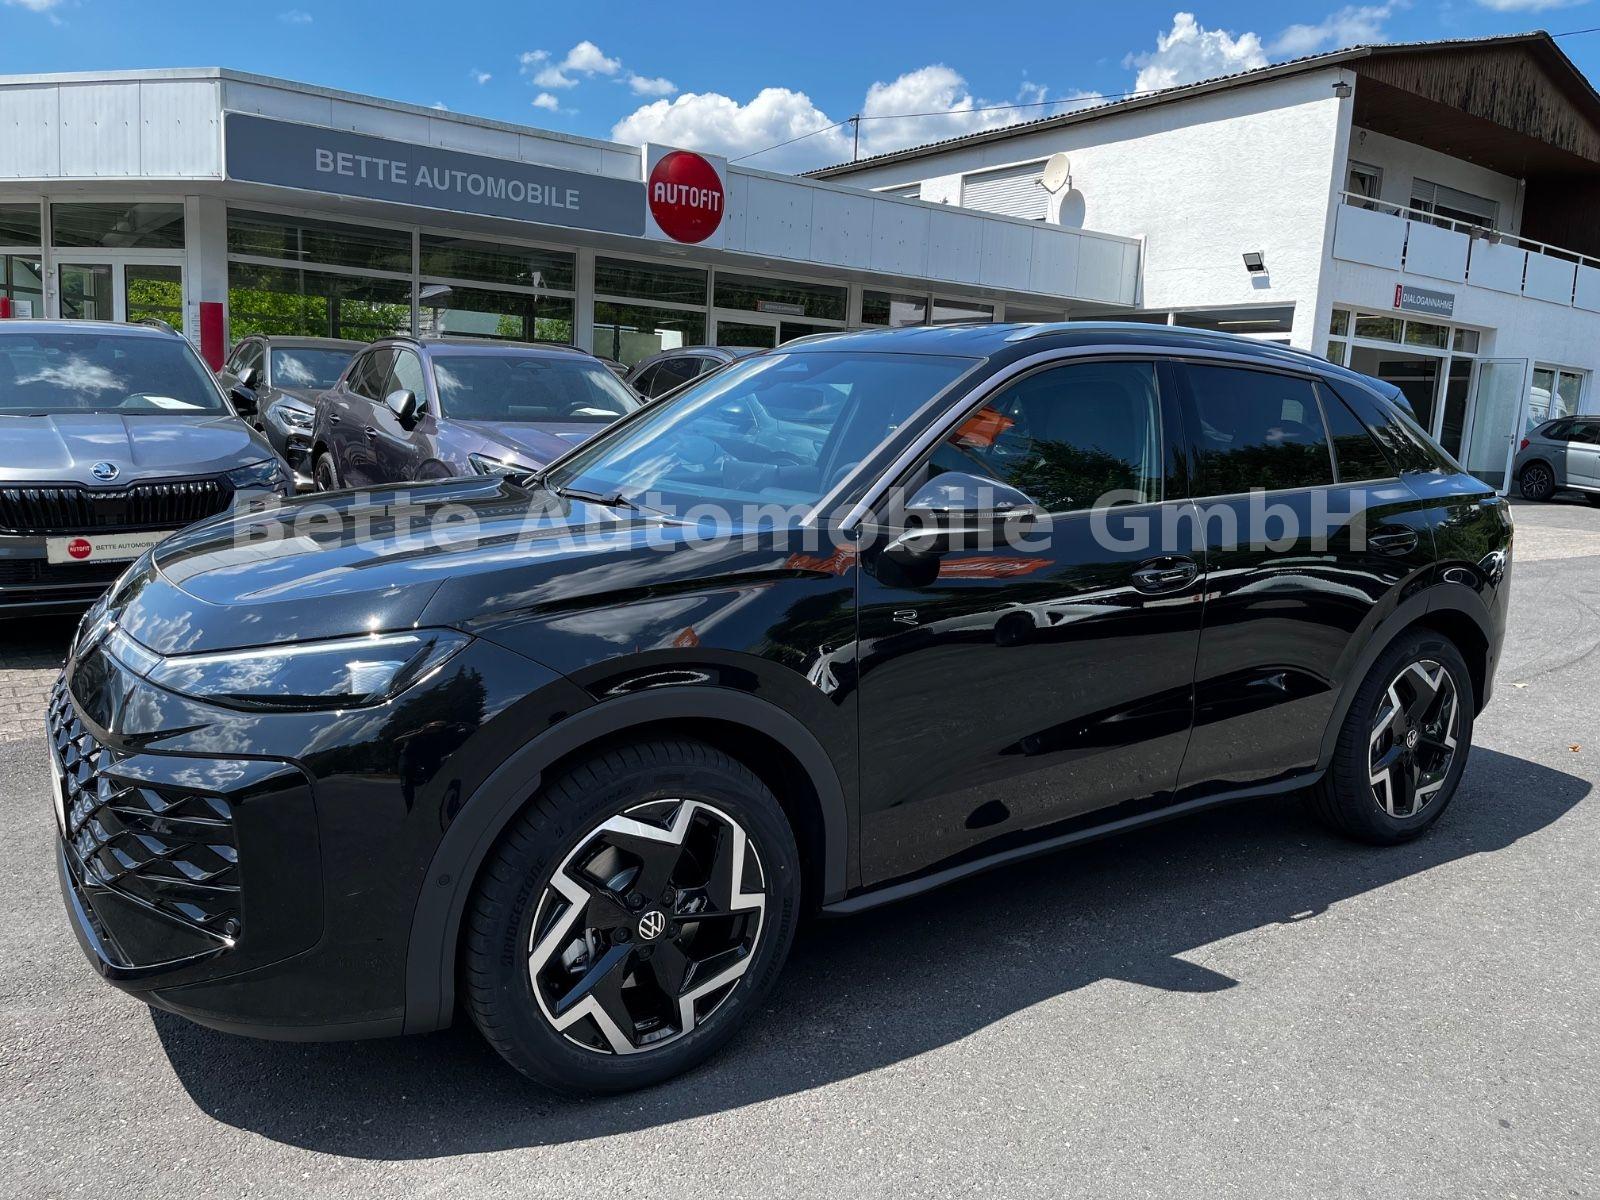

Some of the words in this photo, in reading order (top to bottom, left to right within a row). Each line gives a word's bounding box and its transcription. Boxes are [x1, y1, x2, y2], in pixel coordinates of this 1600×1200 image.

[315, 148, 408, 184] BETTE
[414, 165, 580, 211] AUTOMOBILE
[653, 181, 721, 212] AUTOFIT
[1402, 293, 1454, 310] DIALOGANNAHME
